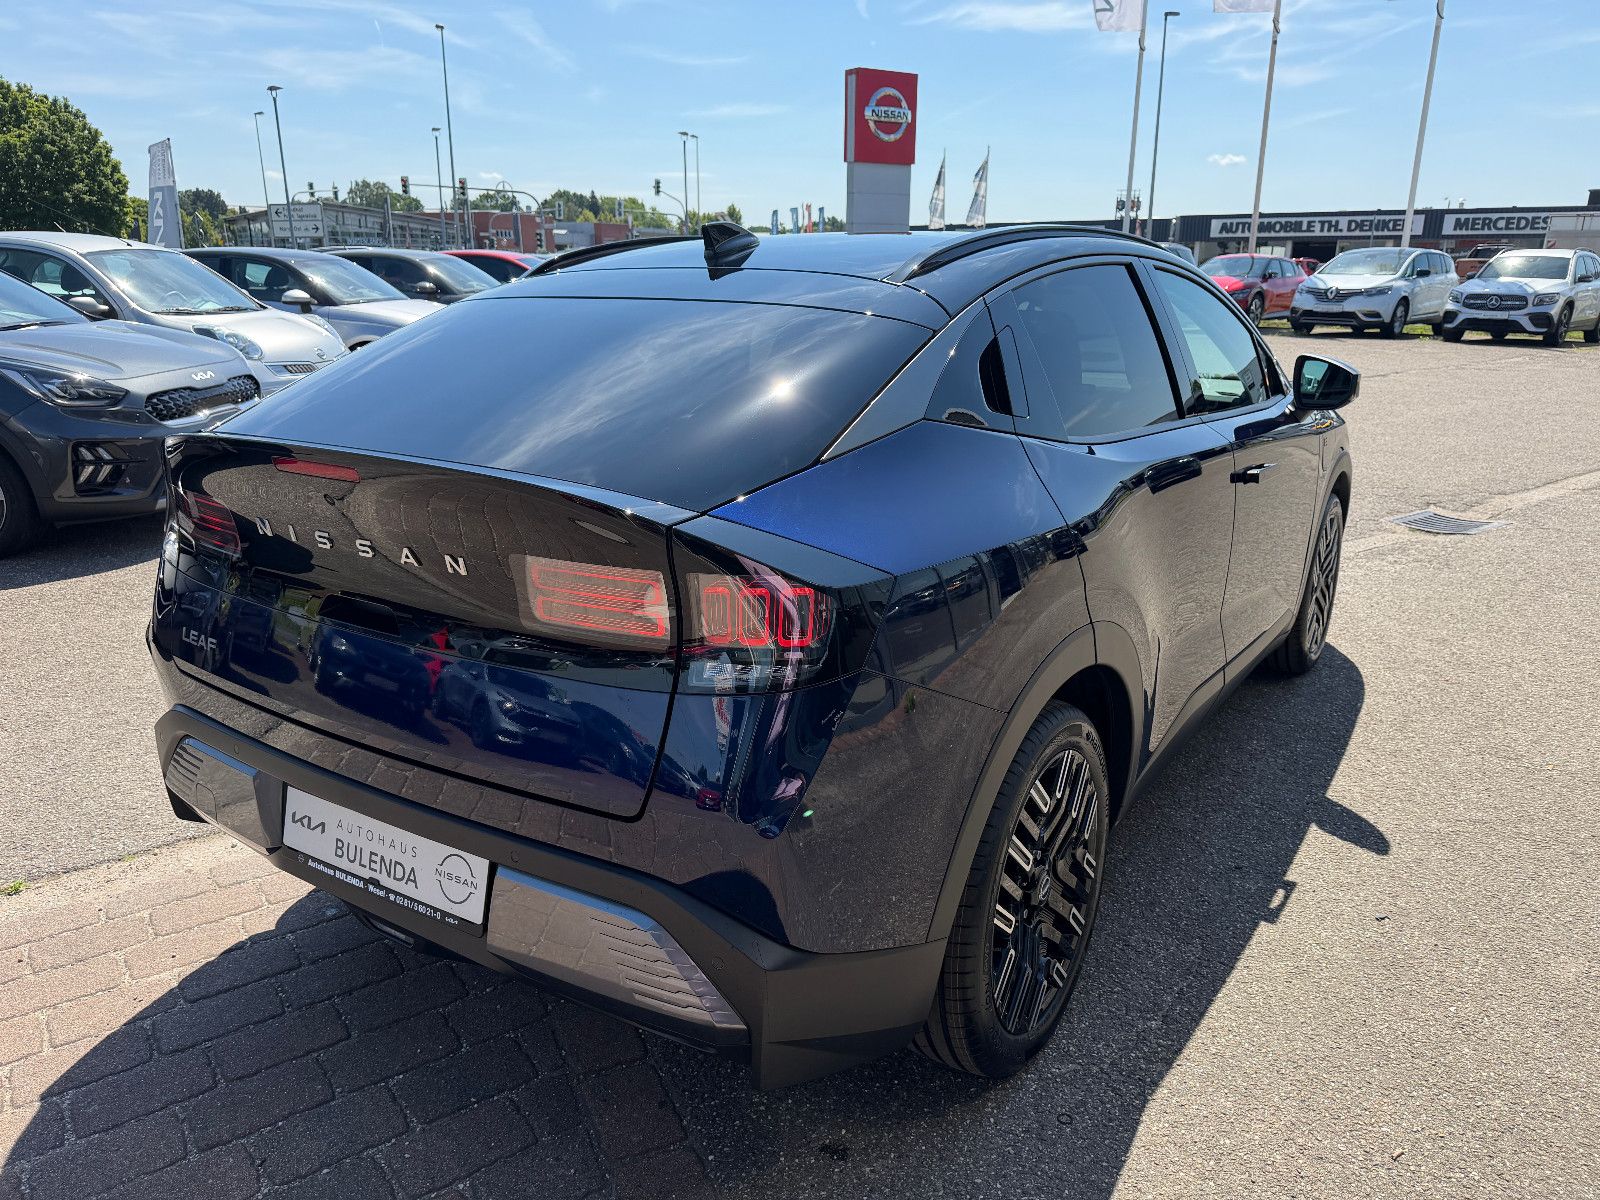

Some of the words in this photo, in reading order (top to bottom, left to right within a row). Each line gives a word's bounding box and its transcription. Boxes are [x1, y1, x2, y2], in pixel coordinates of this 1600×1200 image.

[871, 109, 909, 120] NISSAN
[1317, 219, 1343, 233] TH.
[1453, 215, 1550, 231] MERCEDES
[255, 516, 468, 576] NISSAN
[182, 626, 217, 651] LEAF
[291, 811, 326, 834] KIA
[336, 818, 418, 858] AUTOHAUS
[334, 838, 419, 889] BULENDA
[308, 859, 334, 876] Autohaus
[335, 870, 364, 889] BULENDA
[368, 883, 386, 898] Wesel
[434, 868, 478, 891] NISSAN
